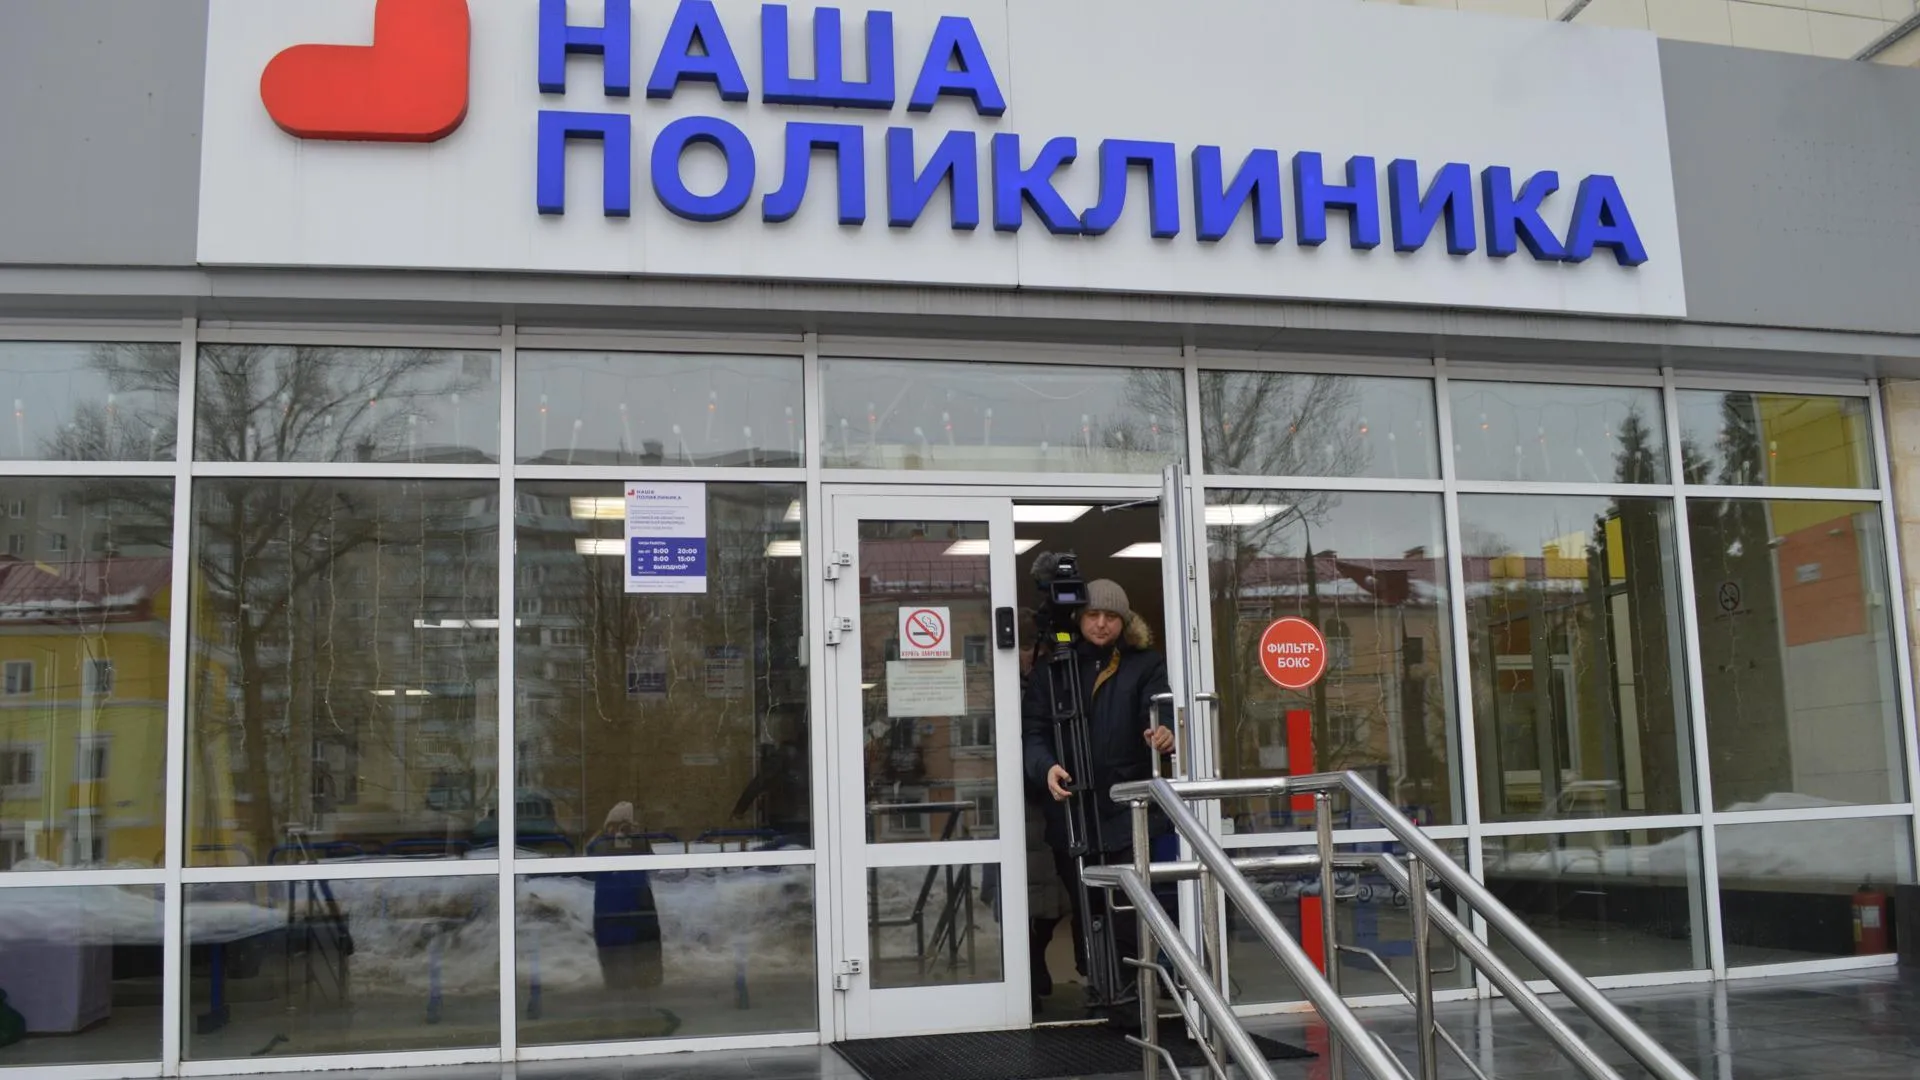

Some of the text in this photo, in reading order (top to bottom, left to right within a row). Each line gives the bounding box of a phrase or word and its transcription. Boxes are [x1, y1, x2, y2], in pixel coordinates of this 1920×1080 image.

[538, 0, 1007, 117] НАША
[537, 110, 1648, 266] ПОЛИКЛИНИКА
[1267, 642, 1320, 653] ФИЛЬТР-
[1277, 657, 1311, 668] БОКС
